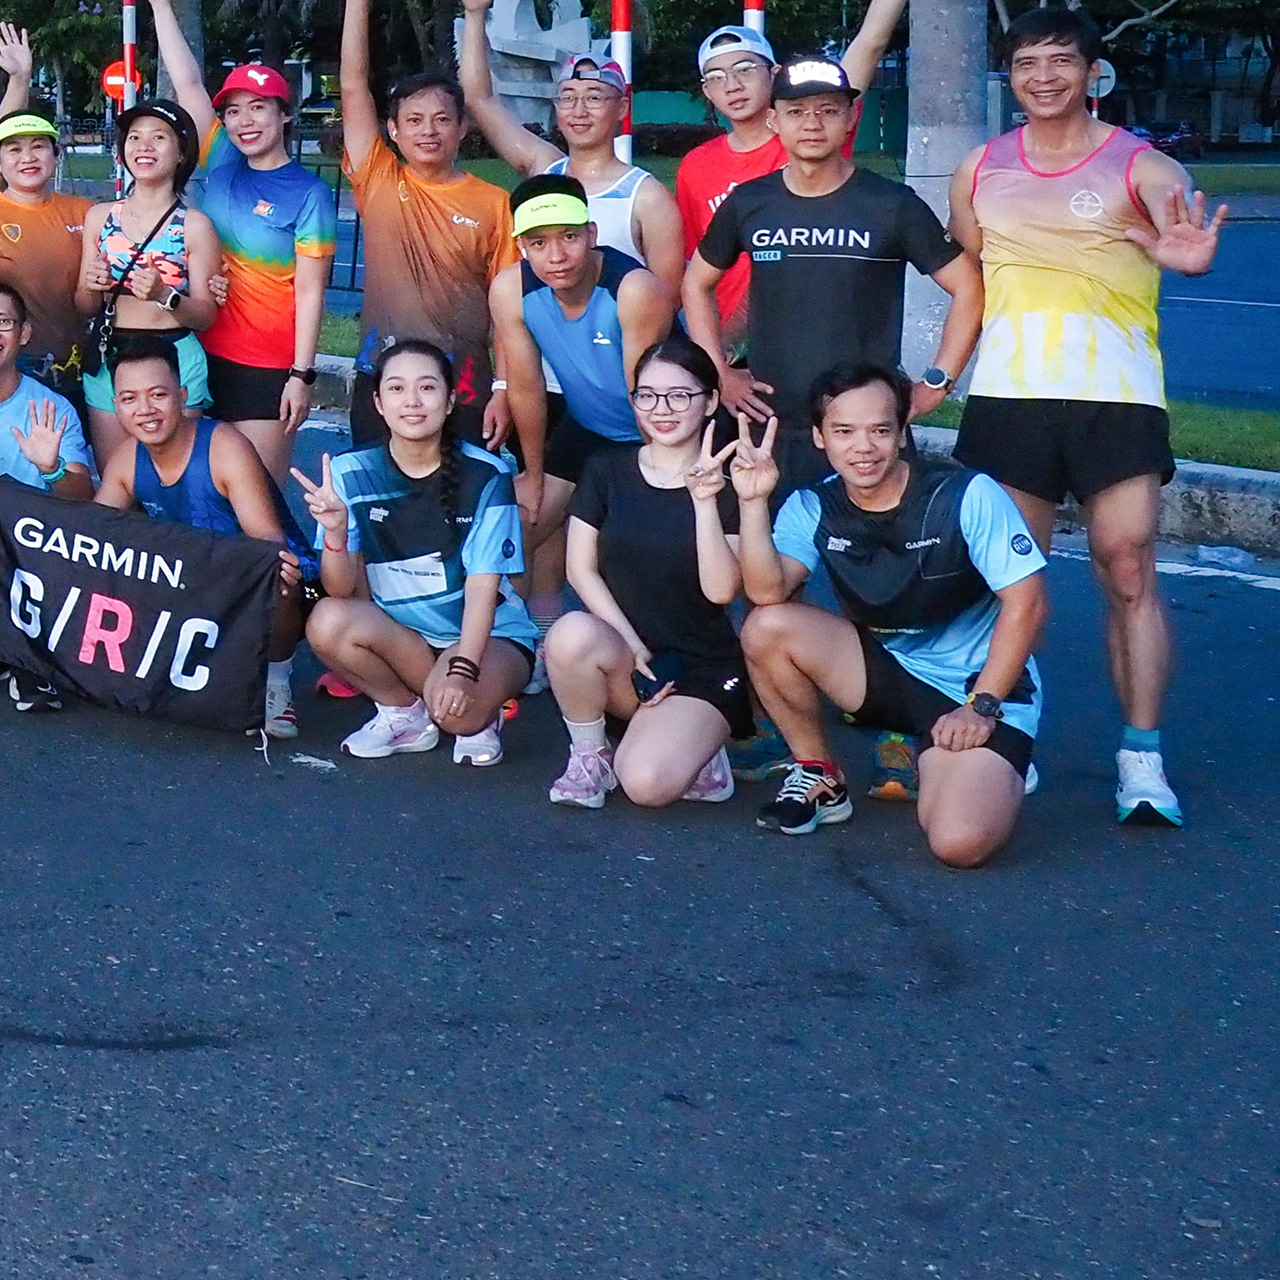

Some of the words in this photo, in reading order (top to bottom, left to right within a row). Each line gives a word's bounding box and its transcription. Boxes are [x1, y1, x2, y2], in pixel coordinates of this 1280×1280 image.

[752, 227, 870, 249] GARMIN
[971, 311, 1163, 403] RUN
[13, 516, 184, 590] GARMIN
[905, 536, 941, 550] GARMIN
